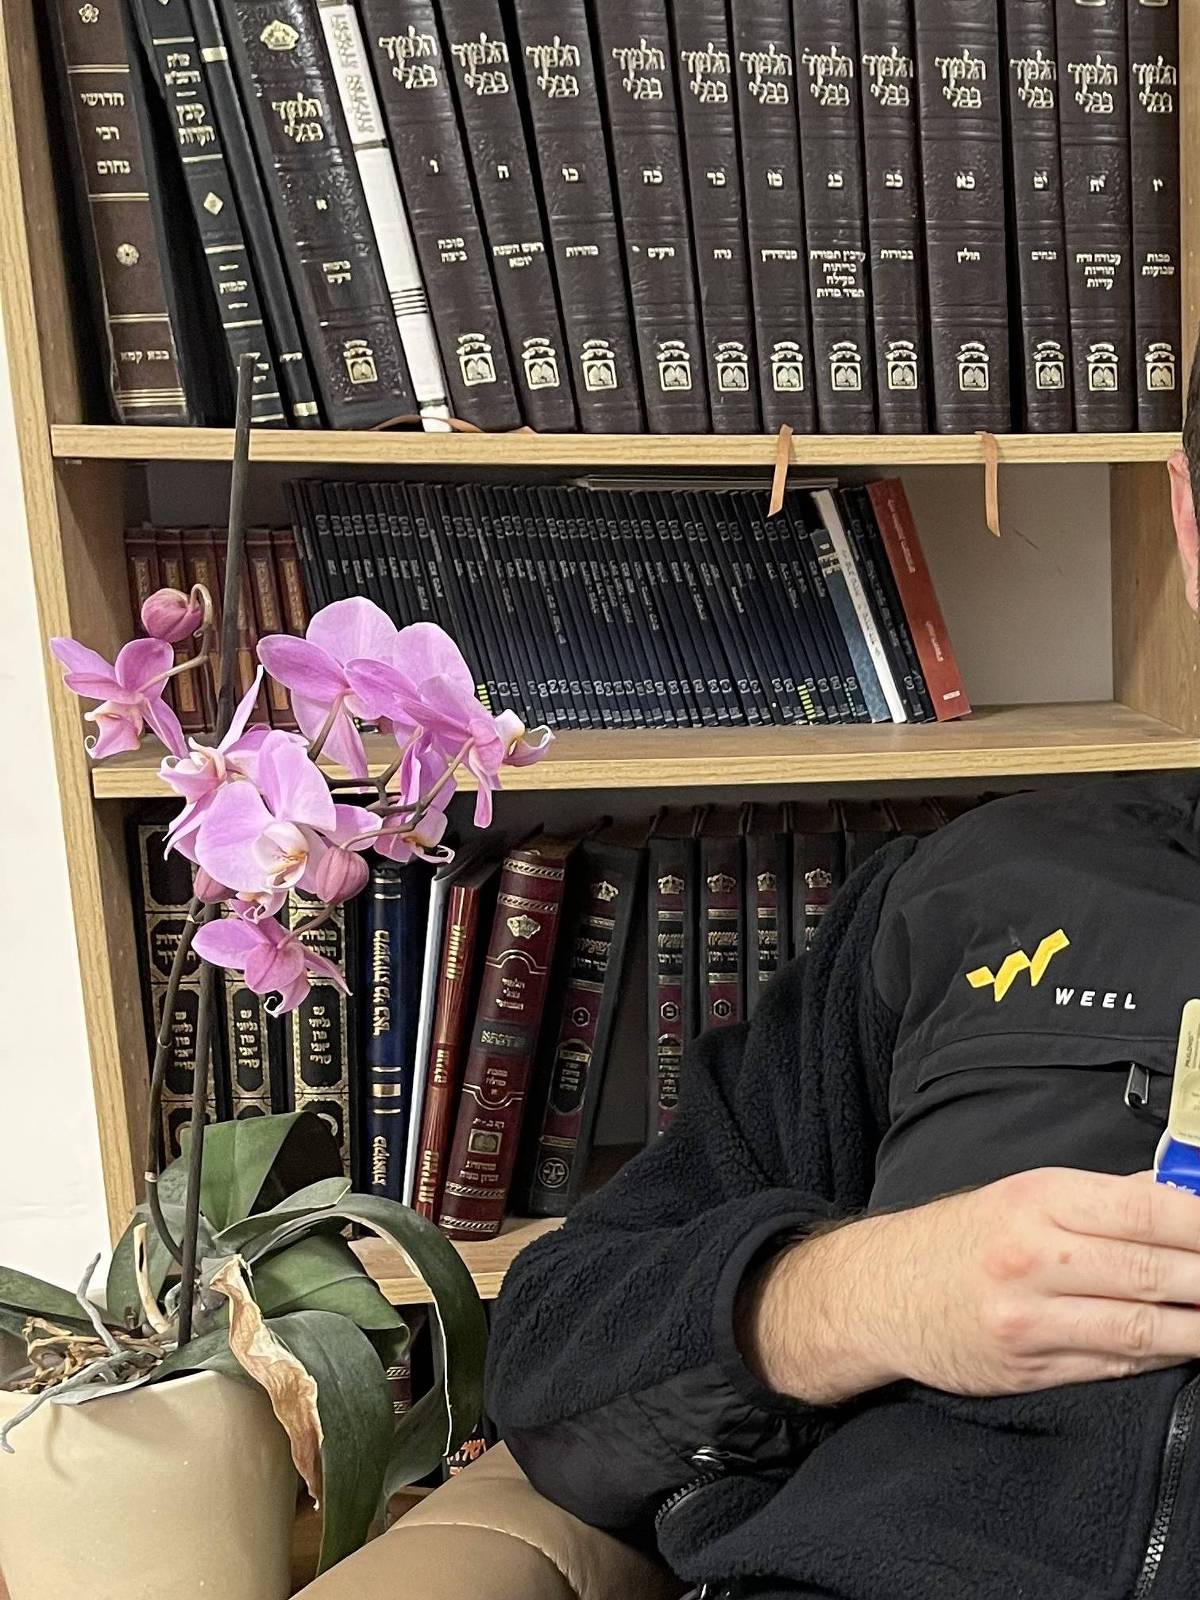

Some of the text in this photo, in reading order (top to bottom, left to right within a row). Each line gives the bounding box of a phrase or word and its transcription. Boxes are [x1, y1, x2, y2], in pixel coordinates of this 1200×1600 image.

[80, 92, 125, 108] חדושי
[95, 126, 120, 141] רבי
[96, 160, 131, 175] נחום
[121, 350, 169, 364] בבא קמא
[372, 929, 391, 1036] משניות מי באר
[1055, 987, 1136, 1010] WEEL
[372, 1135, 390, 1186] מקואות
